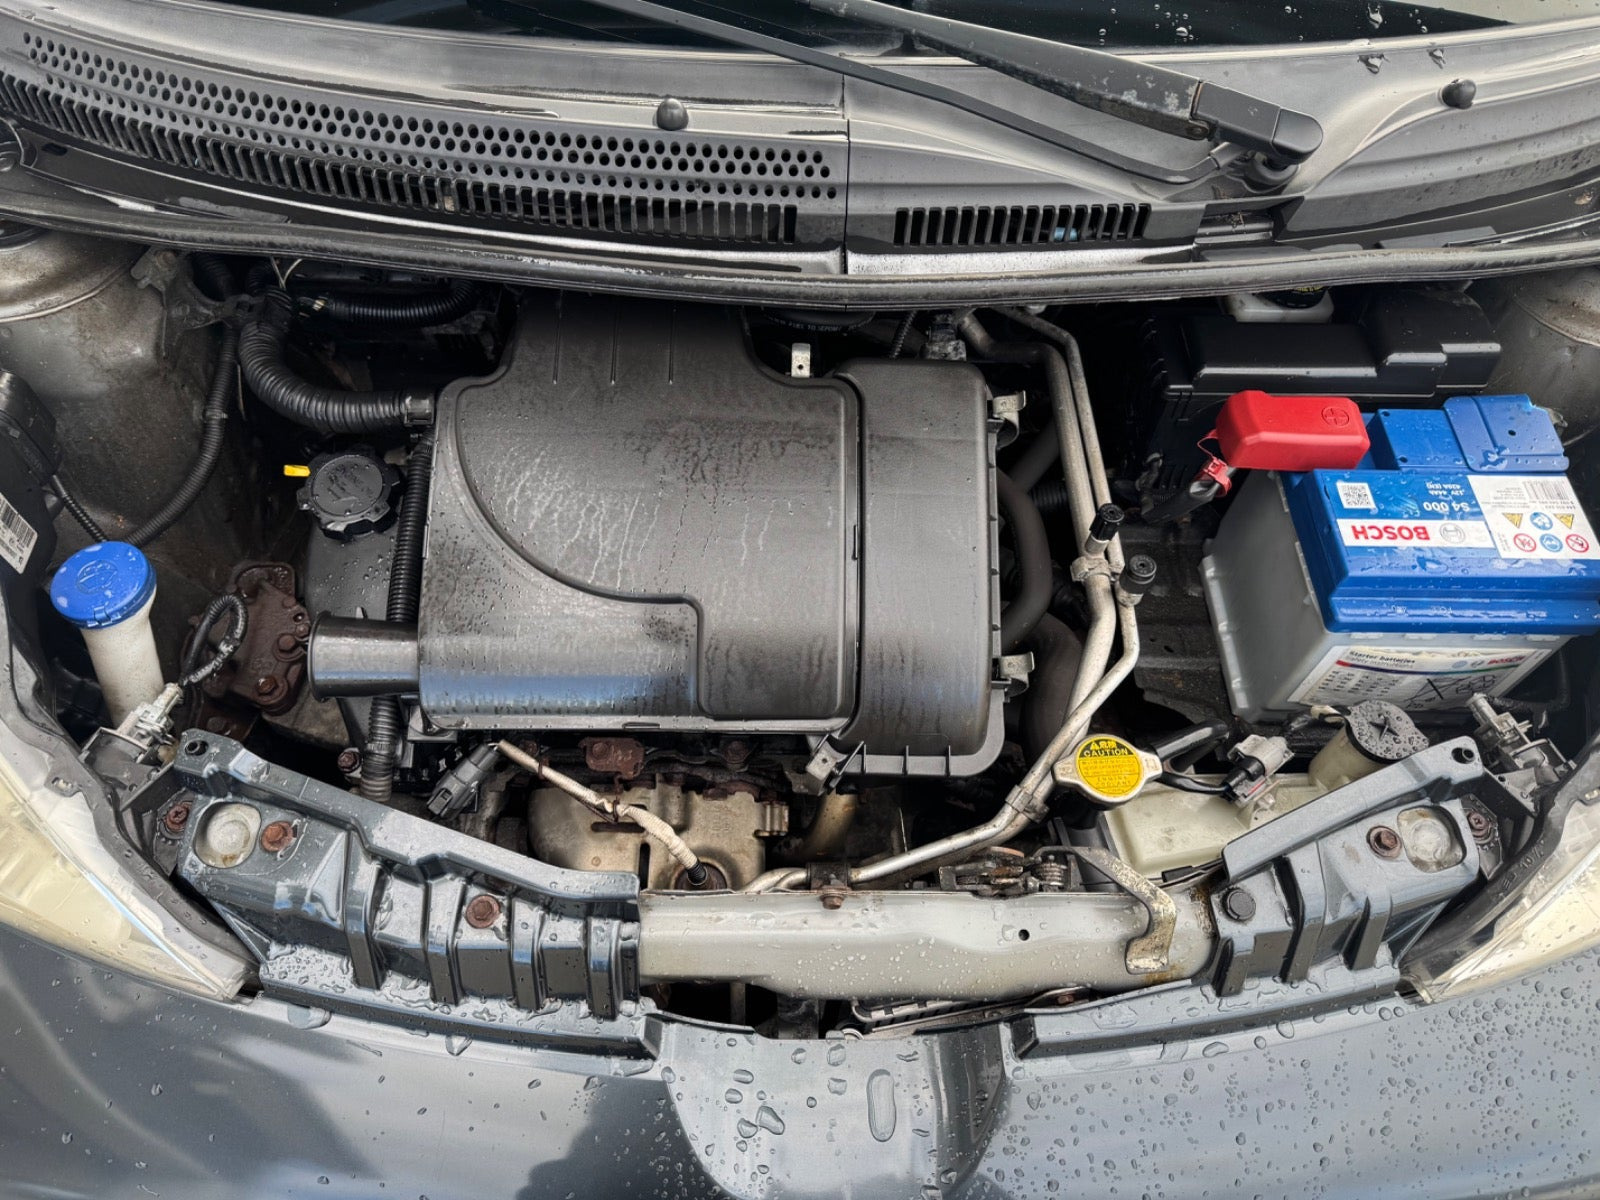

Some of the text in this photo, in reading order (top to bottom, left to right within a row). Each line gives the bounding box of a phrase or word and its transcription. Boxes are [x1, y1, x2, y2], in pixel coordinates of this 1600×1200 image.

[1423, 501, 1450, 512] 000
[1451, 502, 1471, 512] S4
[1350, 525, 1430, 541] BOSCH
[1349, 650, 1416, 664] Starter batteries
[1083, 748, 1129, 757] CAUTION
